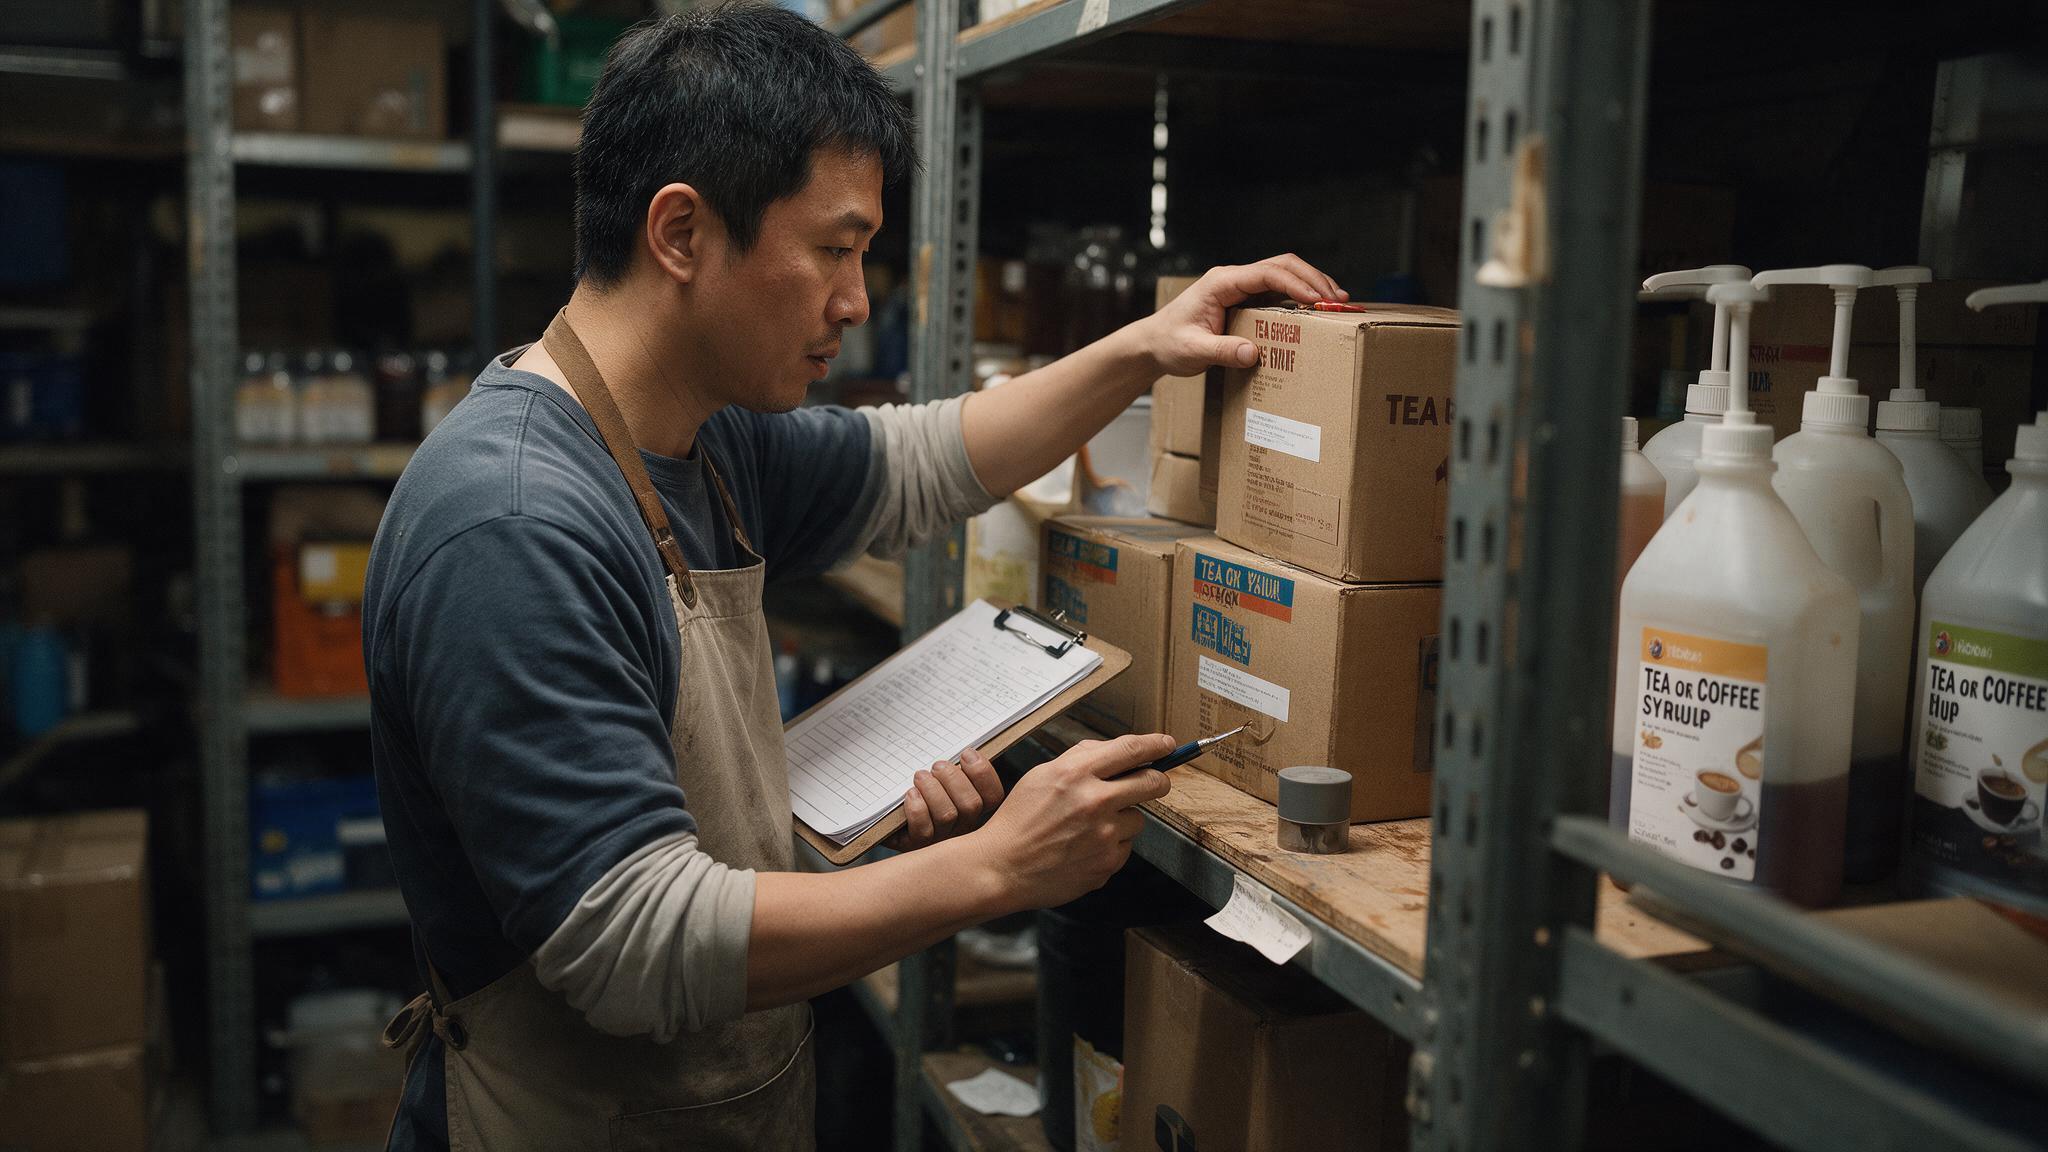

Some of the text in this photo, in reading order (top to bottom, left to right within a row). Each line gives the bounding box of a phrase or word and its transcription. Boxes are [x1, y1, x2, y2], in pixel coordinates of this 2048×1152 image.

[1255, 320, 1269, 340] TEA
[1385, 394, 1439, 426] TEA
[1201, 559, 1222, 583] TEA
[1644, 667, 1760, 711] TEA OR COFFEE
[1931, 664, 2047, 712] TEA OR COFFEE
